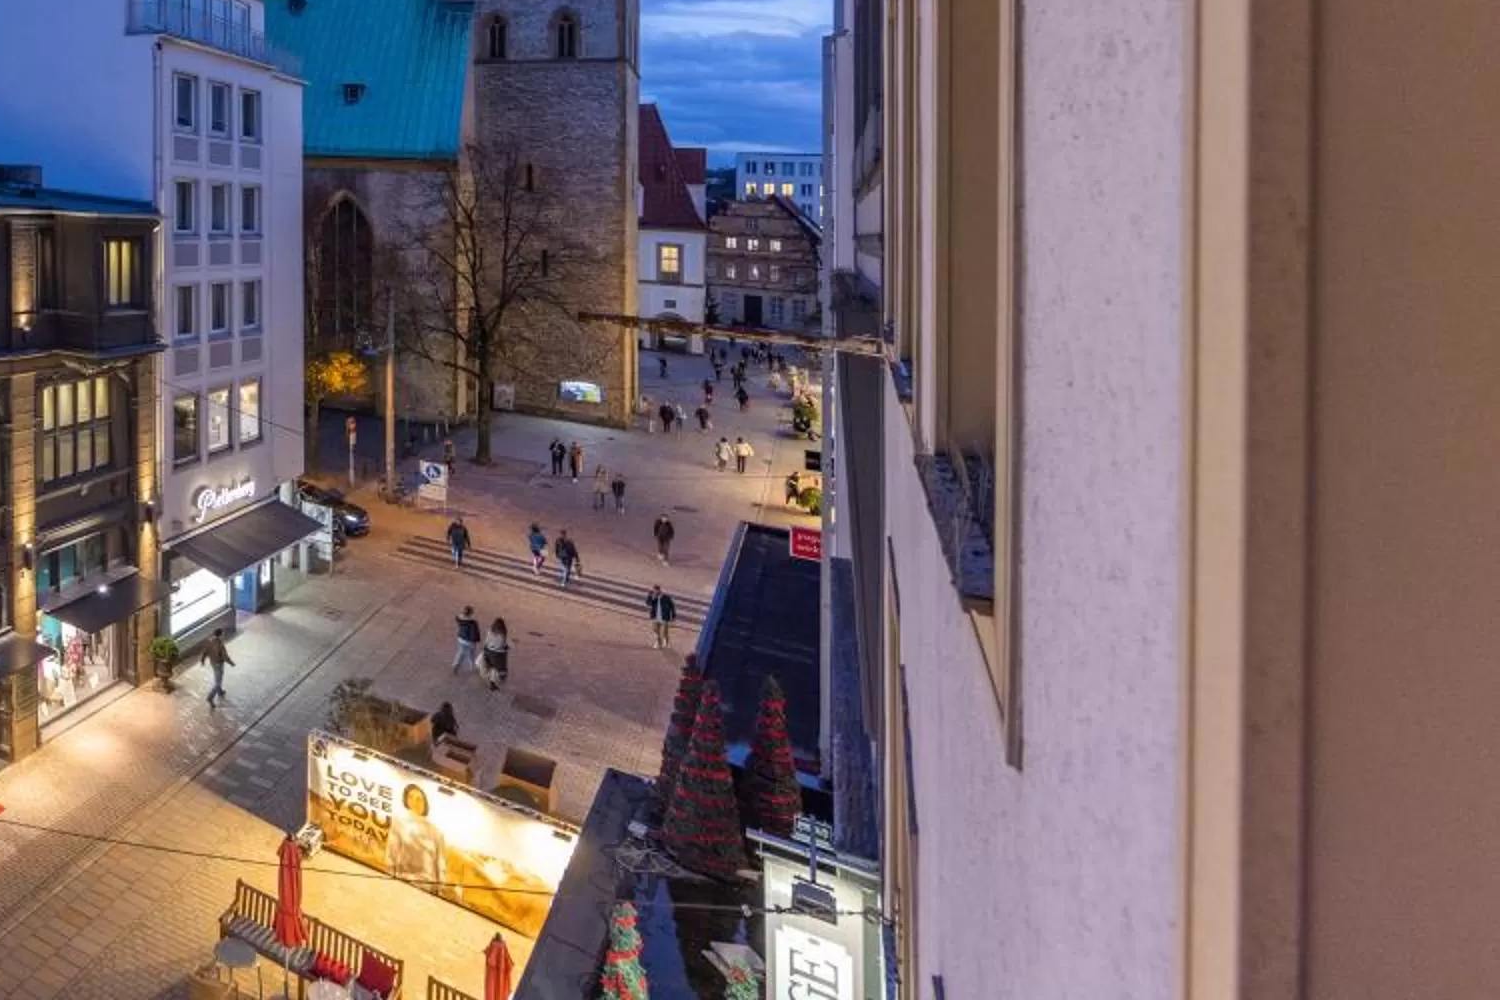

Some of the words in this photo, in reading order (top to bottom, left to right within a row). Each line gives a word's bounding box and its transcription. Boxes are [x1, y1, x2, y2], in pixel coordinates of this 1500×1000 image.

[327, 764, 392, 800] LOVE
[328, 782, 351, 797] TO
[357, 791, 392, 813] SEE
[327, 809, 389, 842] TODAY
[328, 791, 391, 829] YOU
